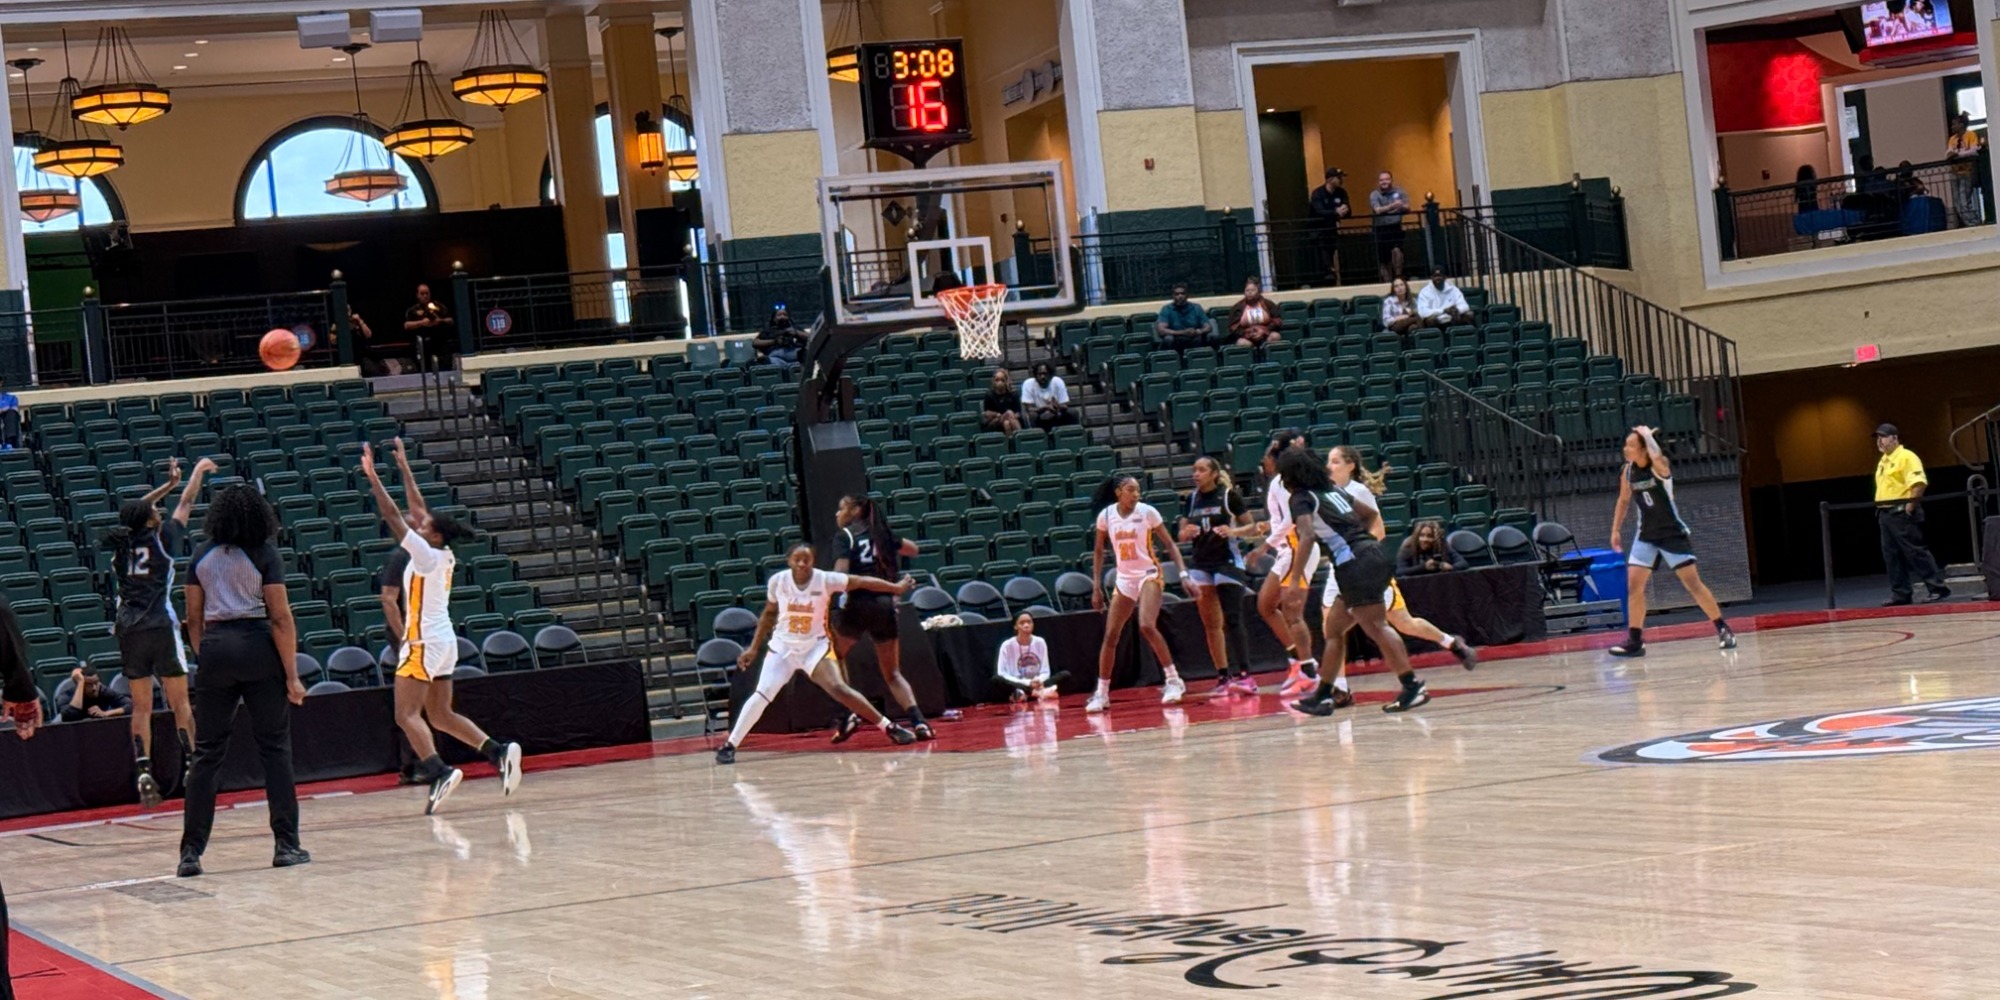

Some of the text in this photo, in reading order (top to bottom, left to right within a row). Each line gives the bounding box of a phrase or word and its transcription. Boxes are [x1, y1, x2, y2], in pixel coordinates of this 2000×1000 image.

[893, 48, 954, 79] 3:08
[908, 80, 948, 132] 16
[1325, 491, 1353, 514] 10
[128, 547, 149, 575] 12
[858, 539, 878, 563] 2
